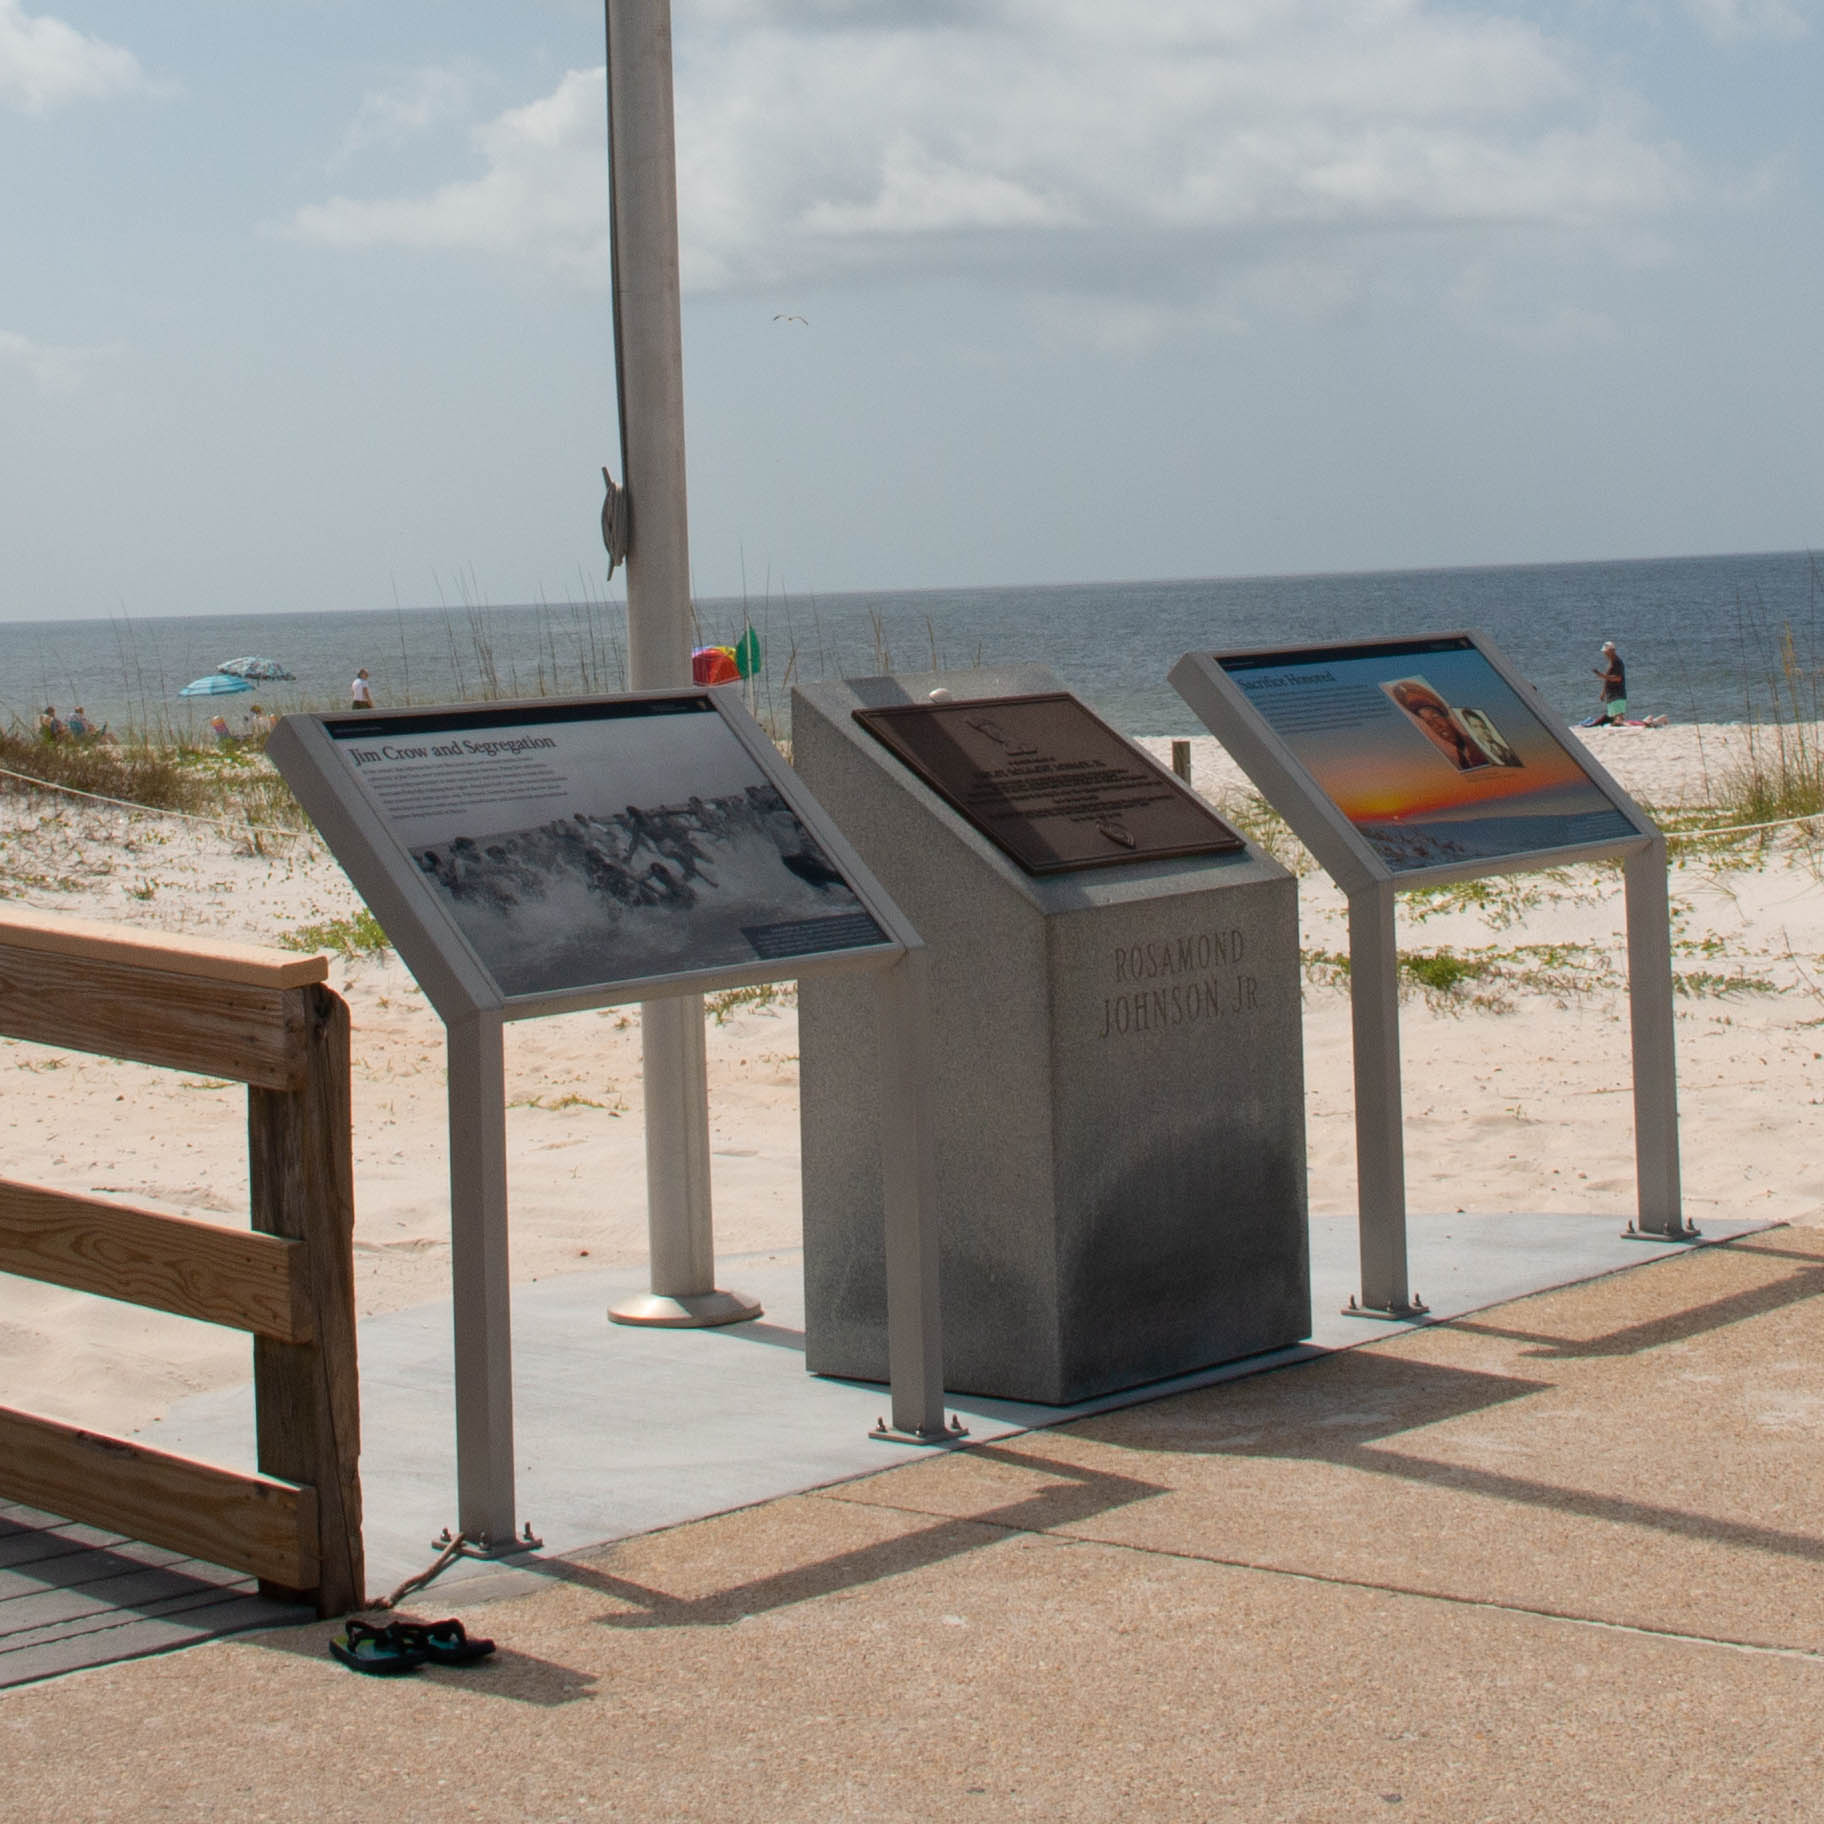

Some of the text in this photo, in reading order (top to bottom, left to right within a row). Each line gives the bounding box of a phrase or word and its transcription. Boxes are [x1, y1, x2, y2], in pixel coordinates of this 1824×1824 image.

[347, 735, 557, 767] Jim Crow and Segregation
[1114, 930, 1244, 983] ROSAMOND
[1232, 975, 1258, 1013] JR
